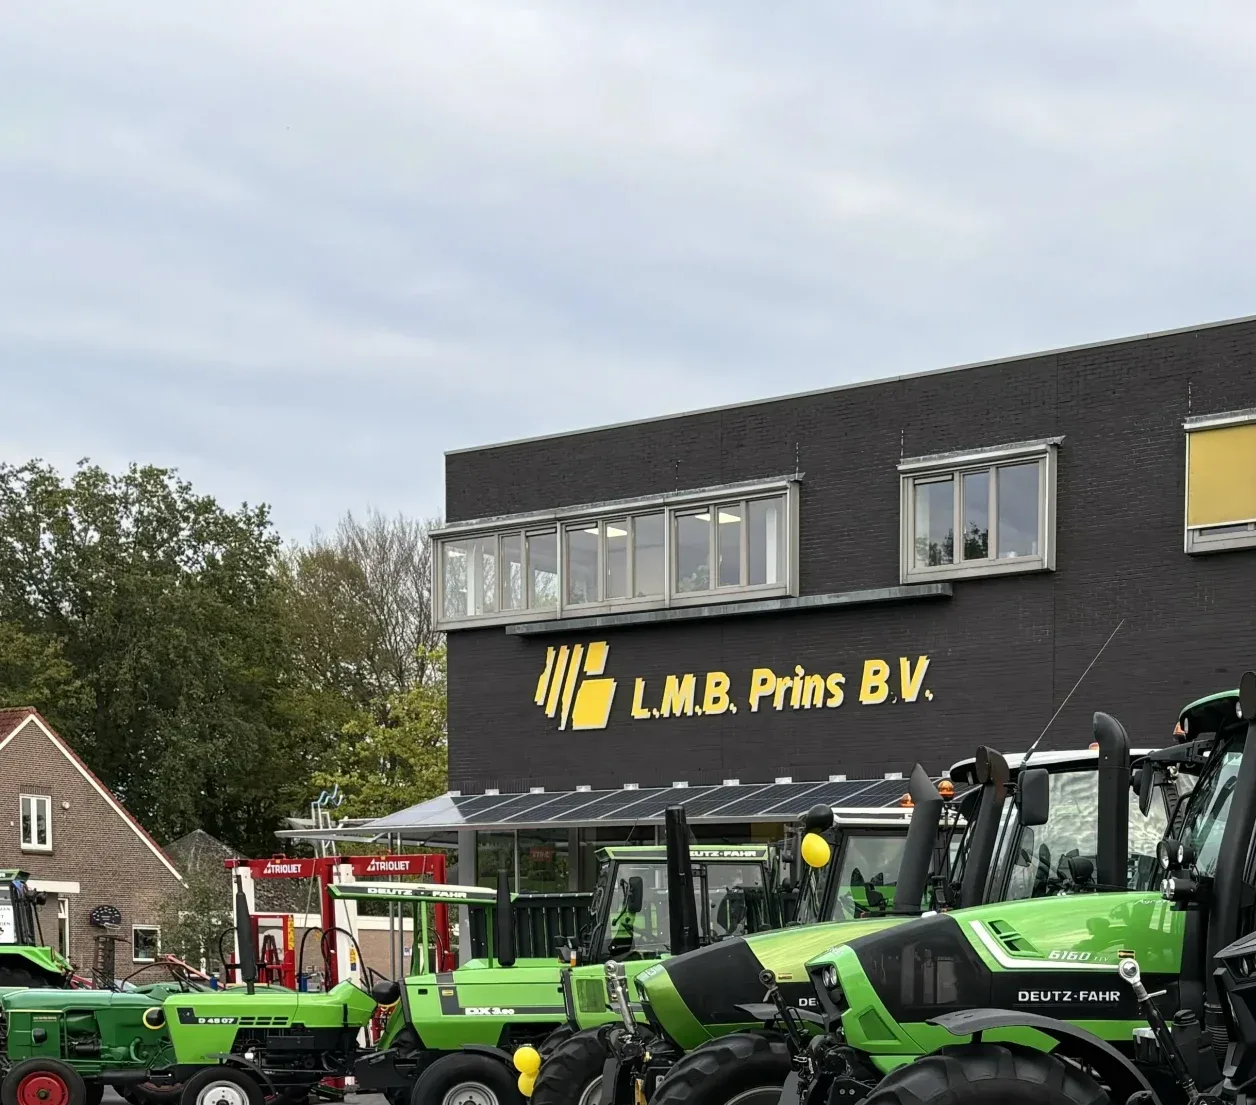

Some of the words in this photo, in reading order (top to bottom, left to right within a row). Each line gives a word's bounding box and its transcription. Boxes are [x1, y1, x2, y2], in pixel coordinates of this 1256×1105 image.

[630, 670, 738, 720] L.M.B.
[748, 664, 846, 713] Prins
[858, 654, 934, 705] B.V.
[269, 864, 302, 874] TRIOLIET
[374, 860, 410, 871] TRIOLIET
[1048, 950, 1092, 961] 6160
